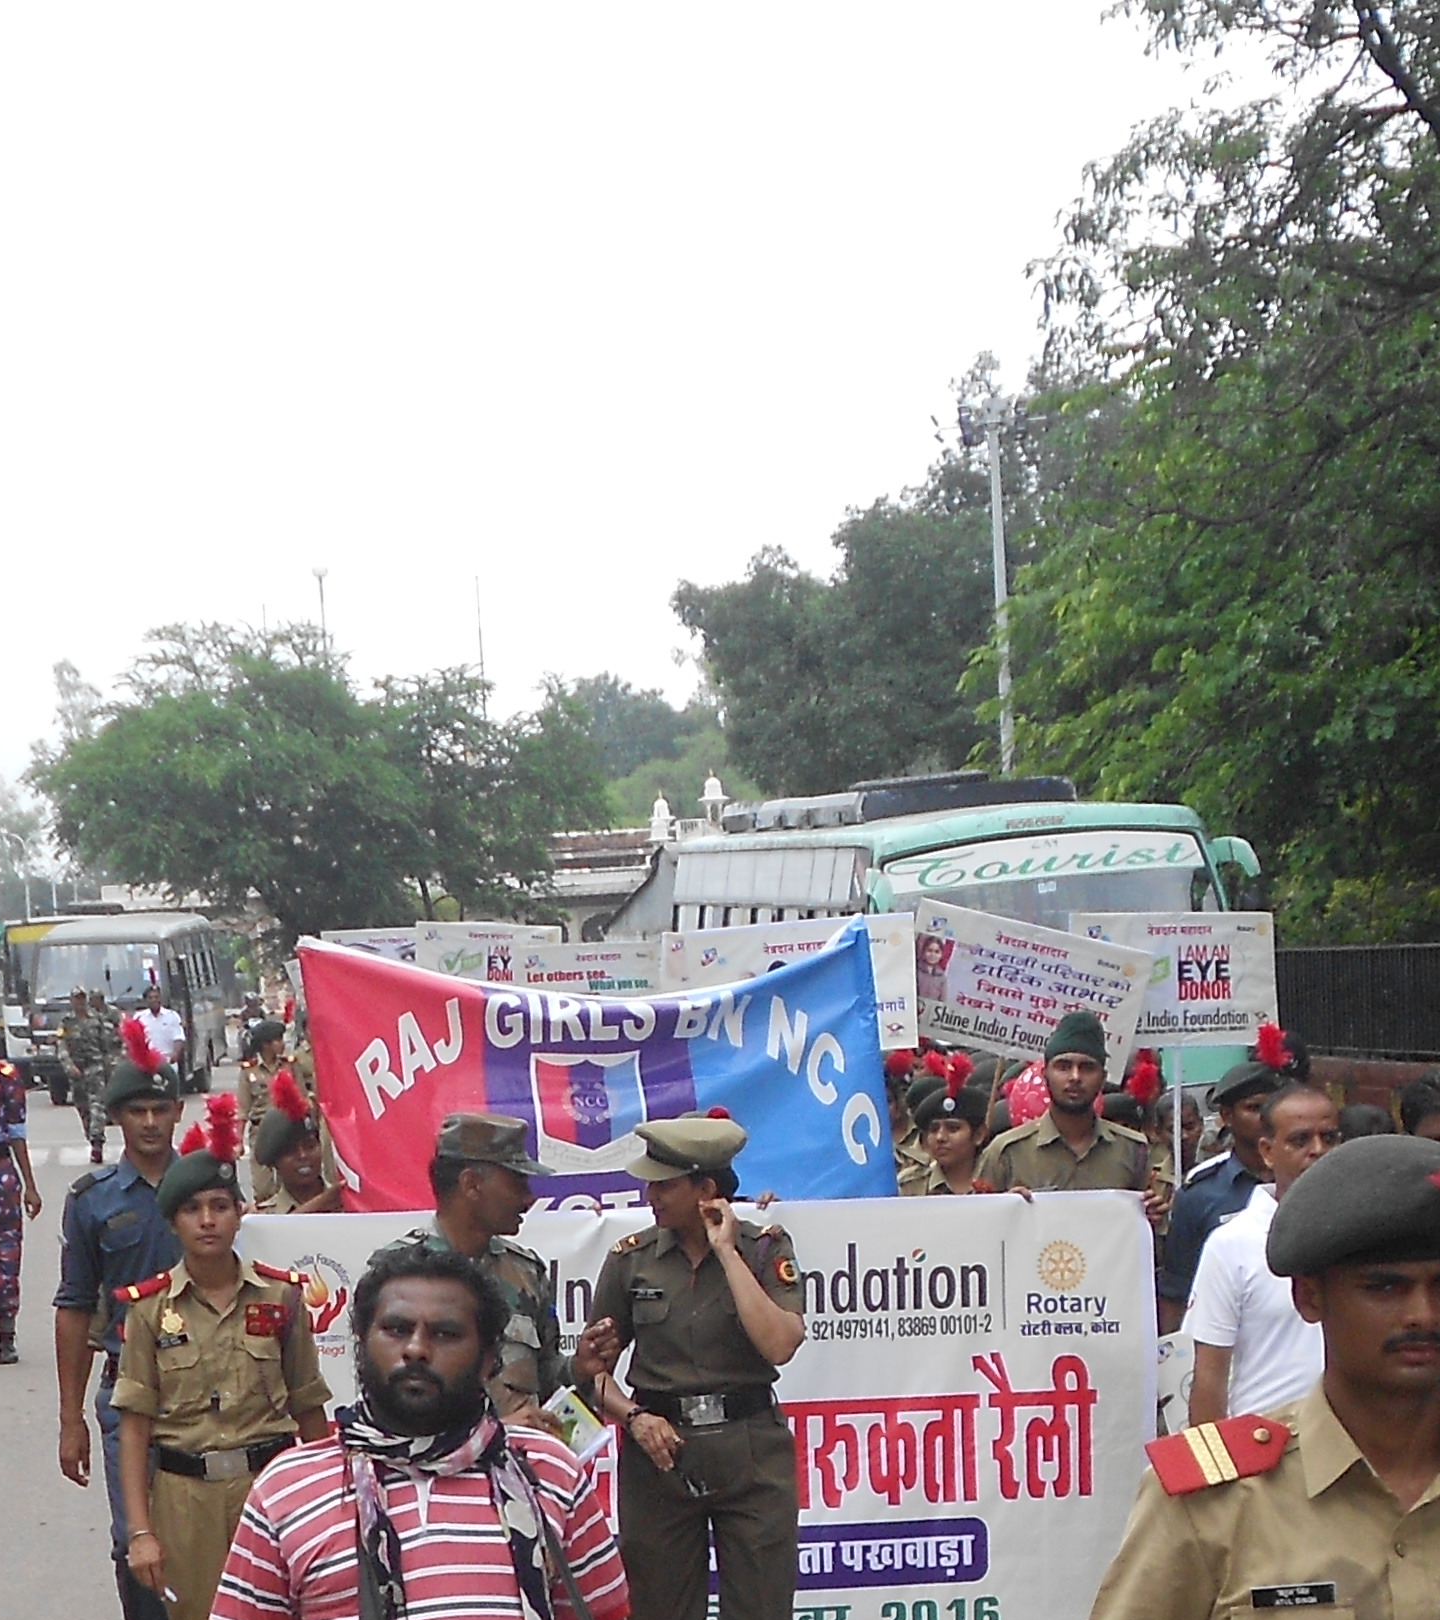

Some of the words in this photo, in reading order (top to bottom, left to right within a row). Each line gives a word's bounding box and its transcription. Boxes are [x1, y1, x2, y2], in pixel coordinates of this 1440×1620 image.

[887, 841, 1205, 889] Tourist
[1031, 942, 1070, 960] महादान
[1186, 944, 1209, 961] AM
[1212, 944, 1231, 961] AN
[487, 955, 512, 971] EY
[1177, 960, 1232, 982] EYE
[526, 972, 545, 983] Let
[546, 970, 585, 983] others
[588, 980, 616, 992] What
[616, 980, 634, 991] you
[1177, 980, 1232, 1001] DONOR
[931, 1004, 971, 1030] Shine
[973, 1015, 1009, 1038] India
[1146, 1008, 1179, 1028] India
[1183, 1007, 1250, 1027] Foundation
[355, 997, 463, 1119] RAJ
[485, 991, 656, 1048] GIRLS
[673, 989, 753, 1048] BN
[573, 1095, 607, 1108] NCC
[801, 1241, 989, 1315] ndation
[1026, 1292, 1107, 1317] Rotary
[811, 1317, 895, 1343] 9214979141,
[897, 1315, 937, 1338] 83869
[940, 1313, 993, 1335] 00101-2
[1020, 1319, 1052, 1337] रोटरी
[1091, 1317, 1121, 1334] कोटा
[971, 1351, 1098, 1501] रैली
[840, 1534, 975, 1578] पखवाड़ा
